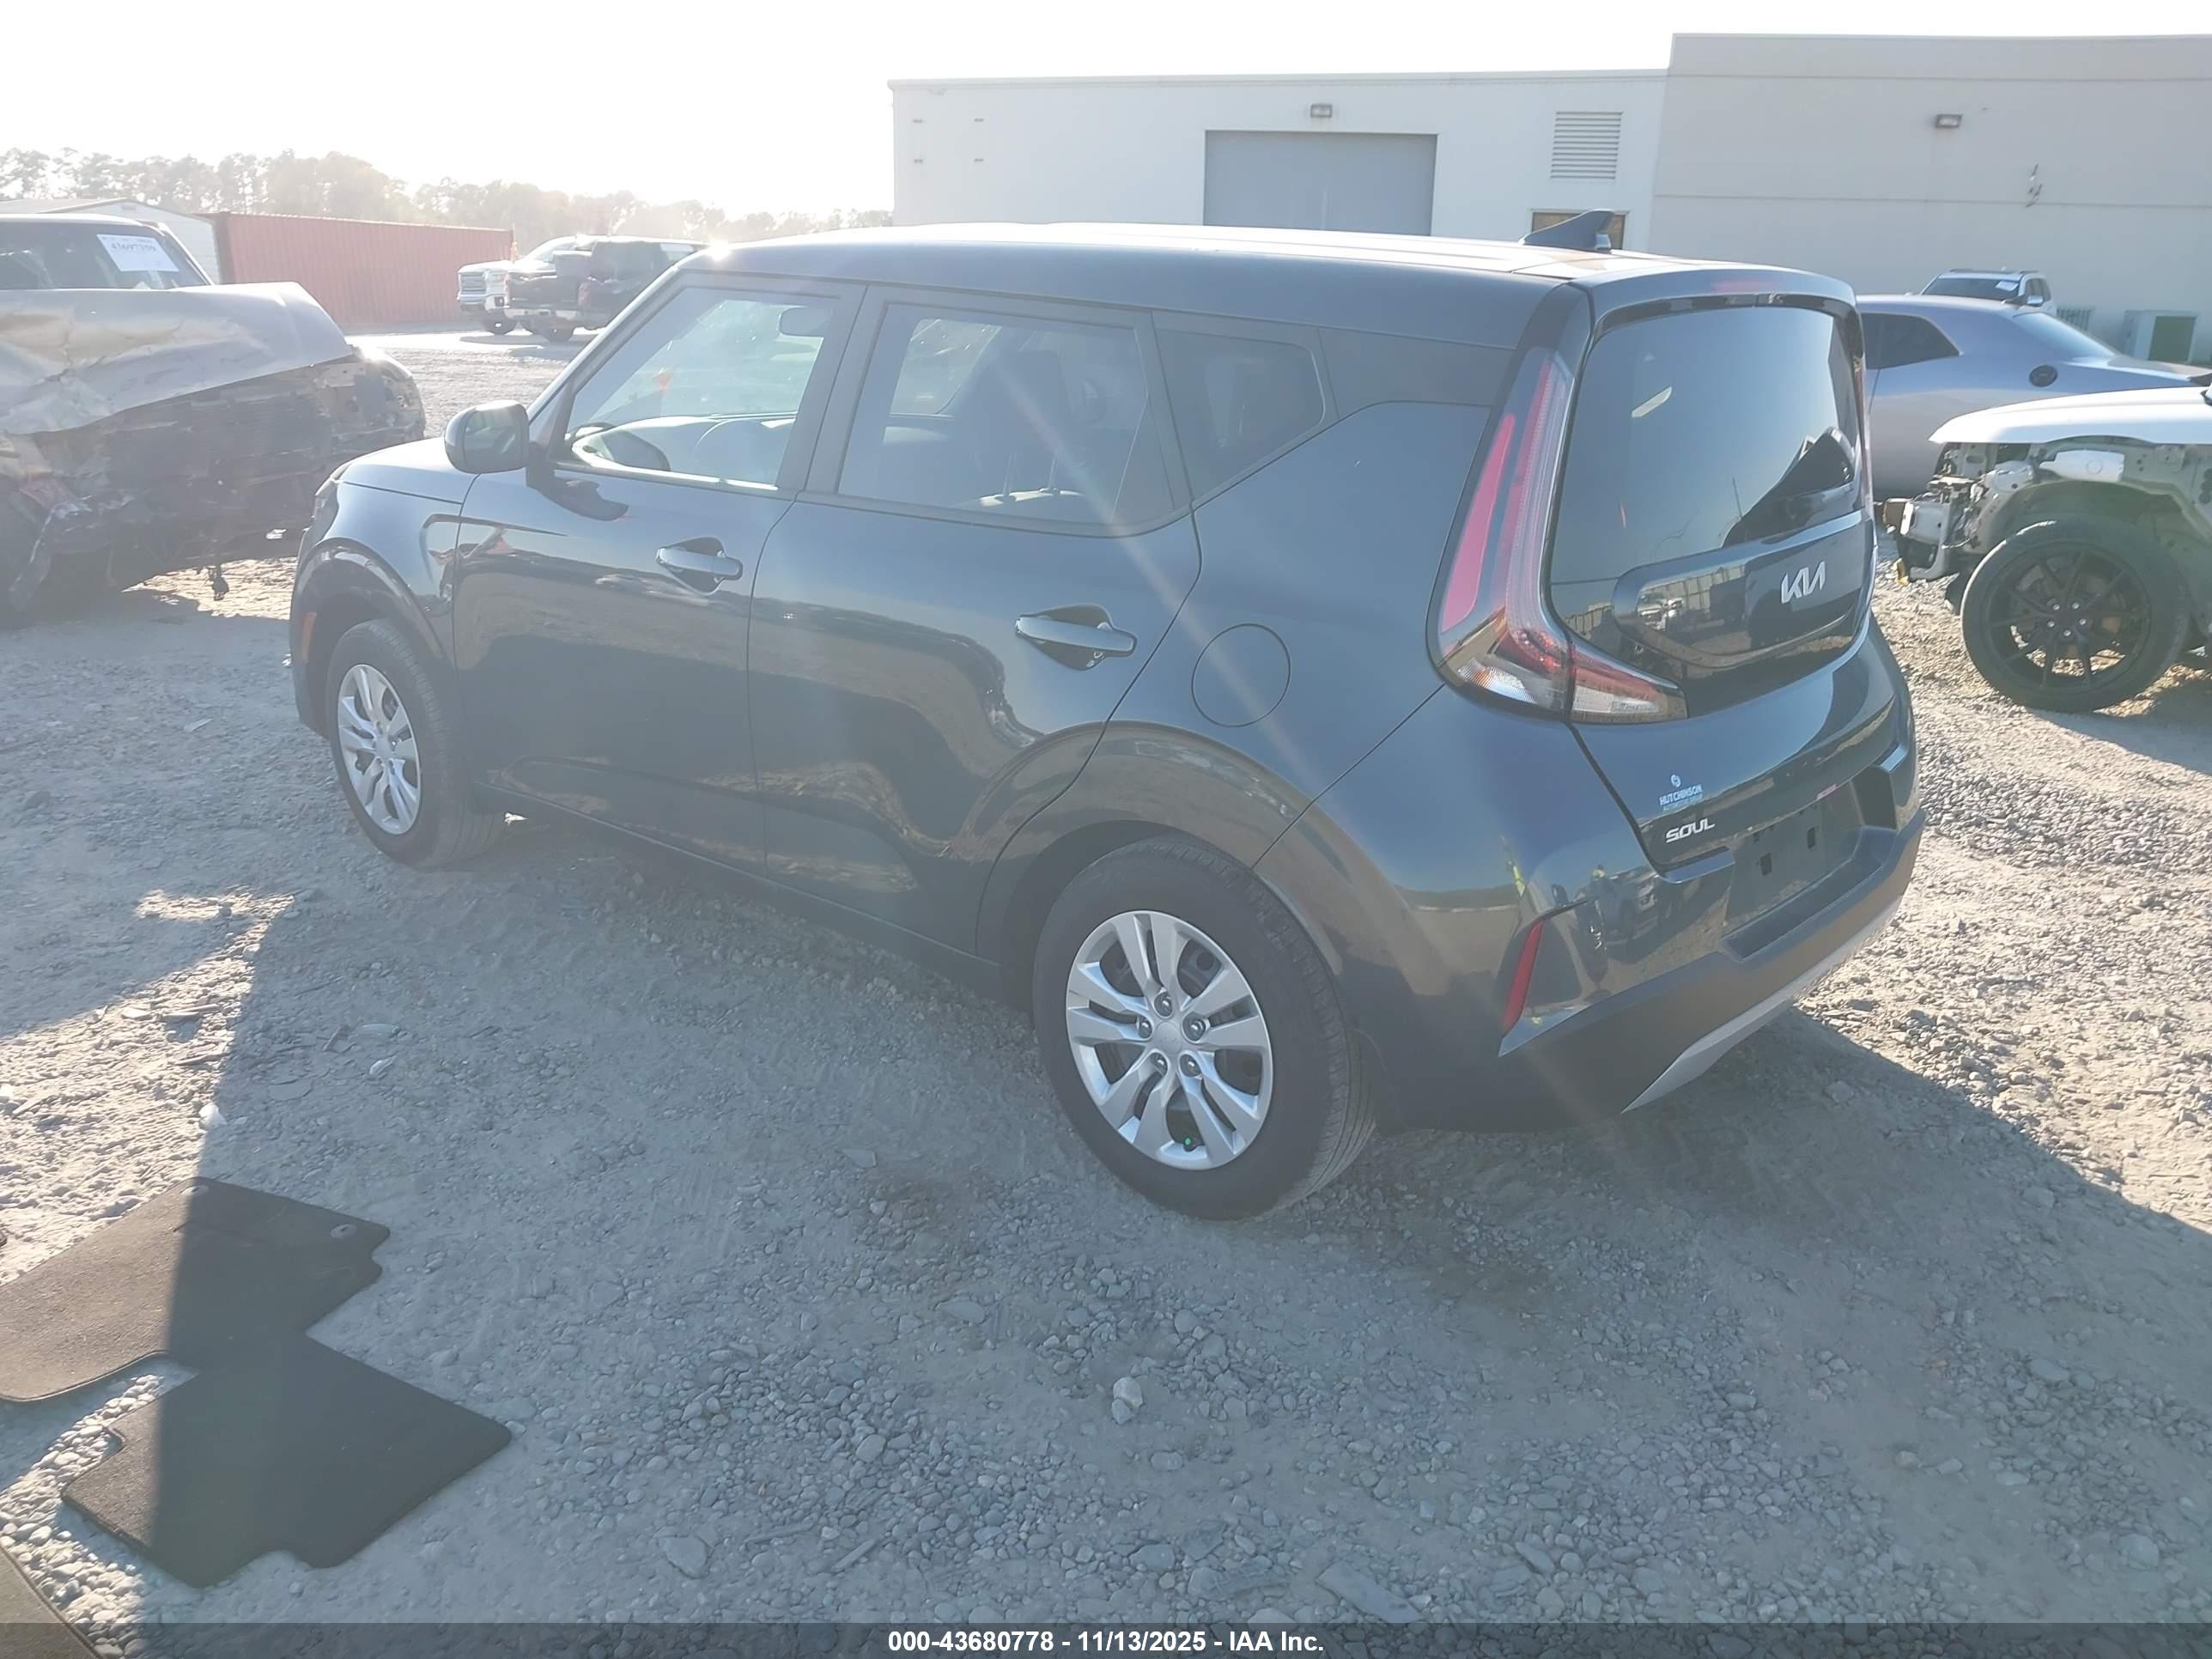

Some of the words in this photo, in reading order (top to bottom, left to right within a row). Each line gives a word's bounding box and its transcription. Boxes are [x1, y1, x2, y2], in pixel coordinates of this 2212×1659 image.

[1781, 561, 1826, 604] KIA
[1659, 784, 1703, 805] HUTCHINSON
[1666, 817, 1716, 843] SOUL
